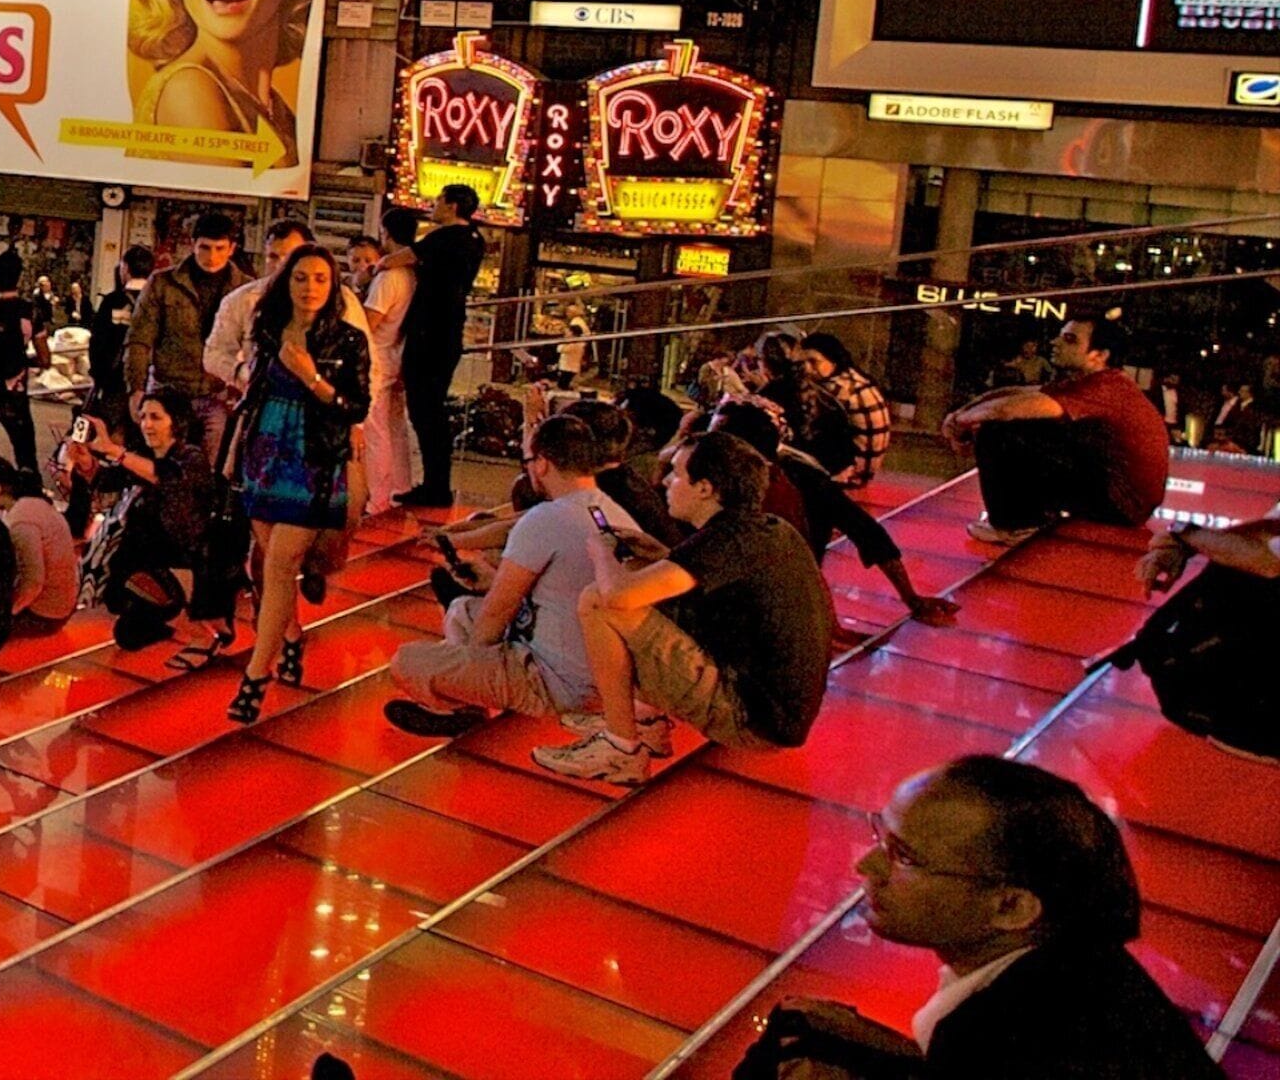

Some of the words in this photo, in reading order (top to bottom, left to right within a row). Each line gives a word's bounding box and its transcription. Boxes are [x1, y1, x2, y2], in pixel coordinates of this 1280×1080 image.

[596, 8, 636, 25] CBS
[415, 77, 517, 150] ROXY
[608, 90, 743, 161] ROXY
[905, 105, 962, 120] ADOBE
[966, 107, 1021, 123] FLASH
[78, 127, 133, 142] BROADWAY
[135, 131, 176, 146] THEATRE
[192, 136, 206, 148] AT
[233, 139, 270, 154] STREET
[542, 104, 570, 207] ROXY
[622, 190, 718, 209] DELICATESSEN
[1014, 297, 1067, 321] FIN
